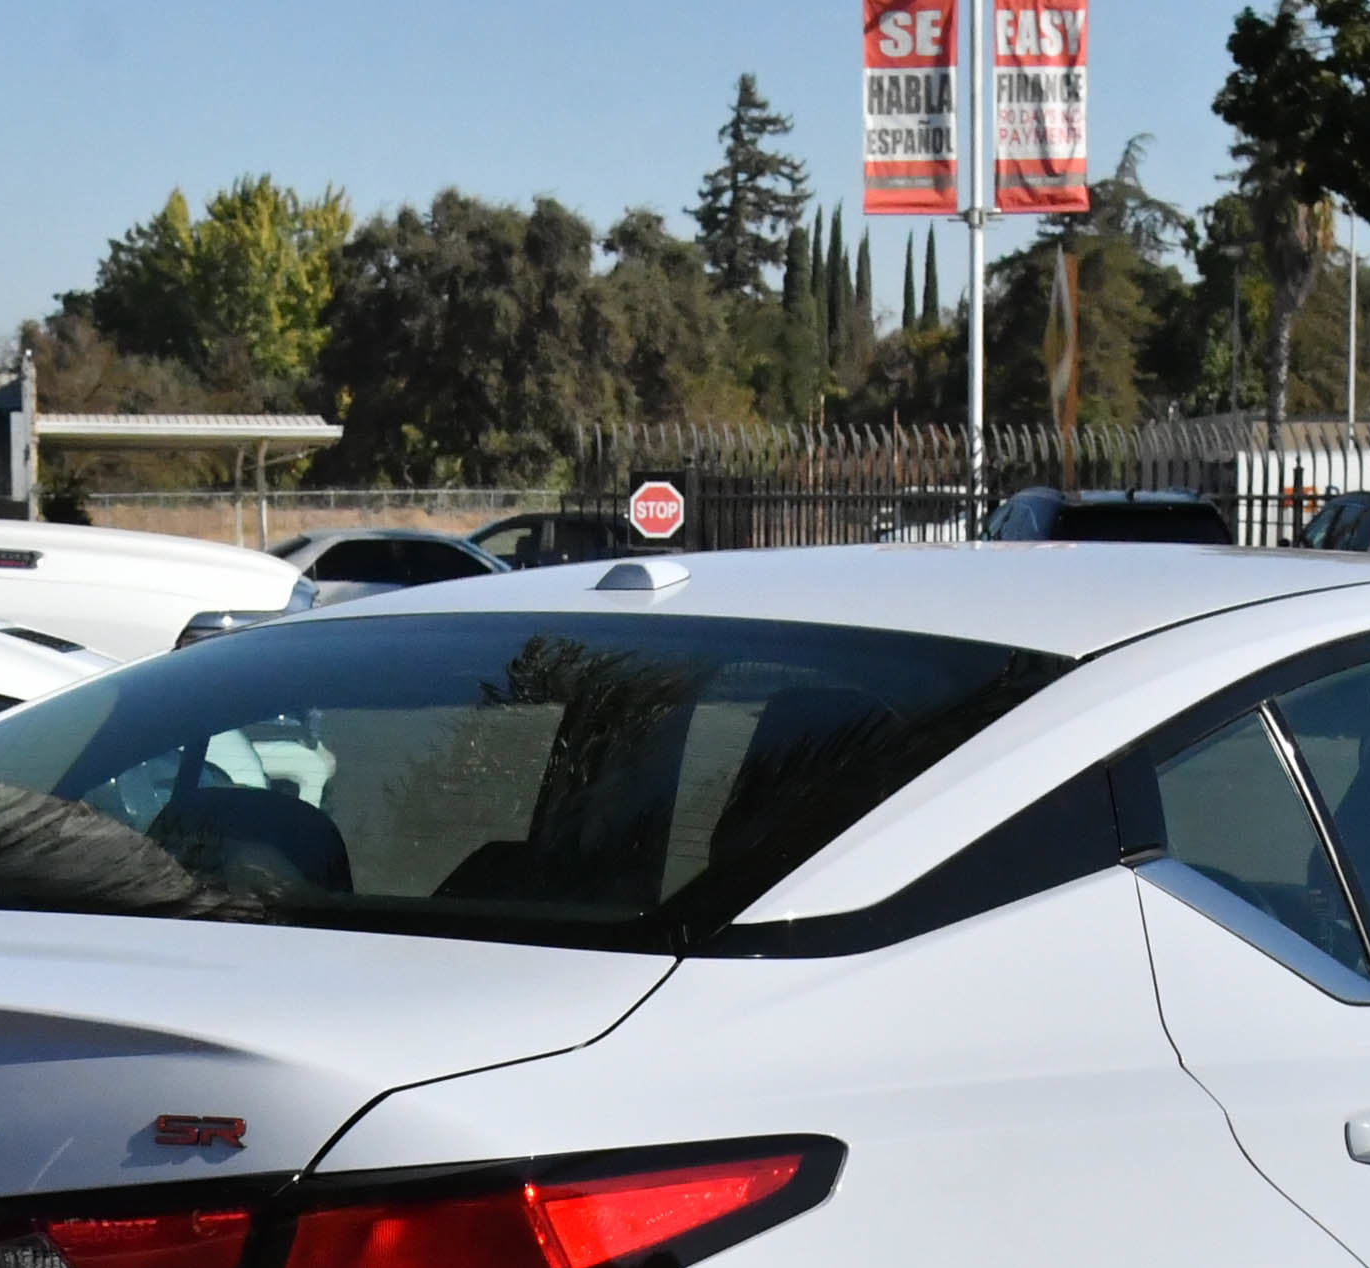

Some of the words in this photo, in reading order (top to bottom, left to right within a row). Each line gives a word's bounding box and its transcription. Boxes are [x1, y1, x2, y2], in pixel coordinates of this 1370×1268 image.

[879, 9, 943, 58] SE
[996, 9, 1086, 57] EASY
[867, 74, 953, 115] HABLA
[996, 73, 1083, 103] FINANCE
[866, 119, 953, 155] ESPAÑOL
[636, 500, 678, 519] STOP
[155, 1114, 247, 1148] SR
